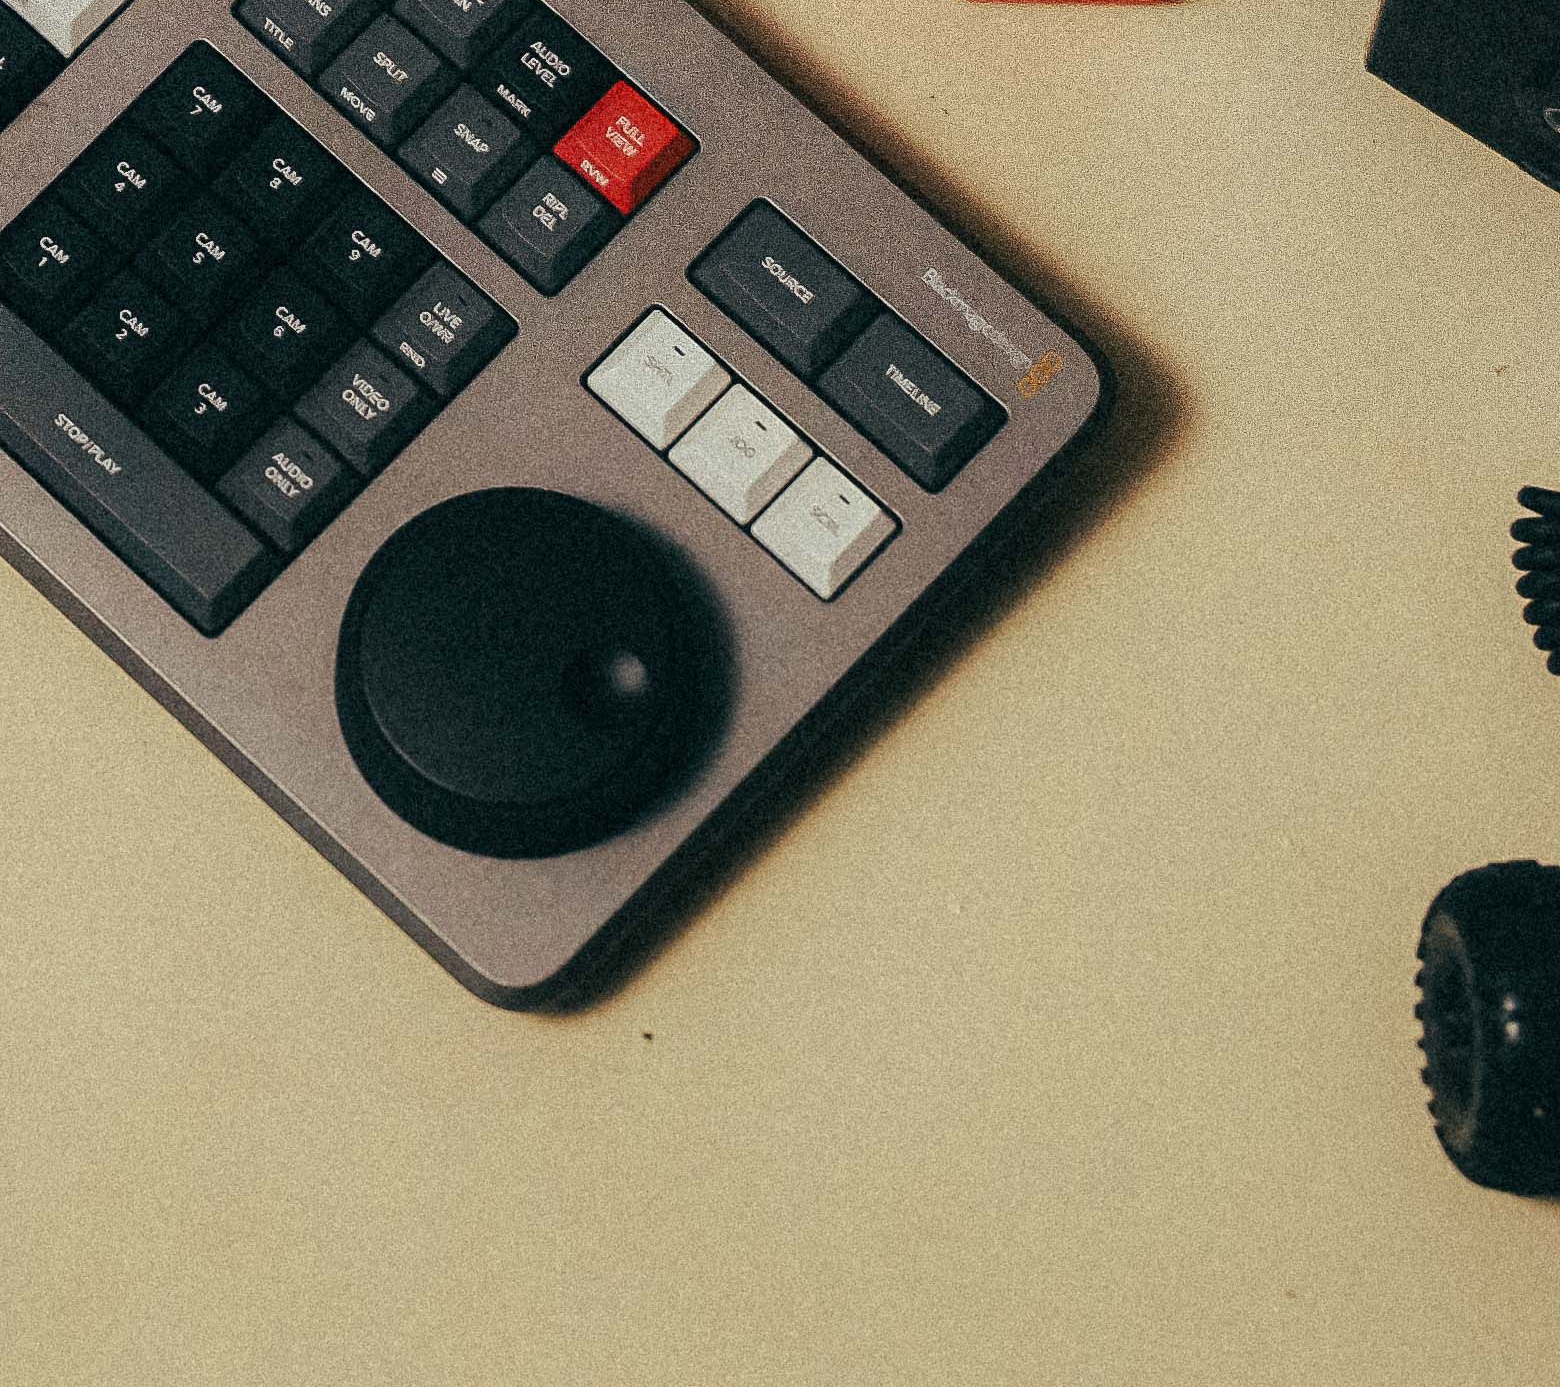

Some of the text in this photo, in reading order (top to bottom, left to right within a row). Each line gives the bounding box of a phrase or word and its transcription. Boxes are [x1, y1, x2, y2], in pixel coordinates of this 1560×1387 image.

[370, 49, 410, 86] SPLIT
[517, 50, 560, 90] LEVEL
[527, 36, 574, 80] AUDIO
[451, 121, 491, 158] SNAP
[602, 125, 638, 159] VIEW
[614, 114, 649, 147] FULL
[530, 203, 560, 232] DEL
[35, 232, 72, 268] CAM
[36, 255, 49, 269] 1
[759, 254, 815, 306] SOURCE
[113, 325, 130, 343] 2
[115, 305, 152, 340] CAM
[431, 300, 464, 331] LIVE
[194, 379, 231, 414] CAM
[338, 386, 378, 423] ONLY
[347, 372, 393, 415] VIDEO
[881, 362, 943, 418] TIMELINE
[191, 400, 209, 418] 3
[51, 411, 124, 478] STOP/PLAY
[261, 464, 301, 501] ONLY
[269, 449, 316, 492] AUDIO
